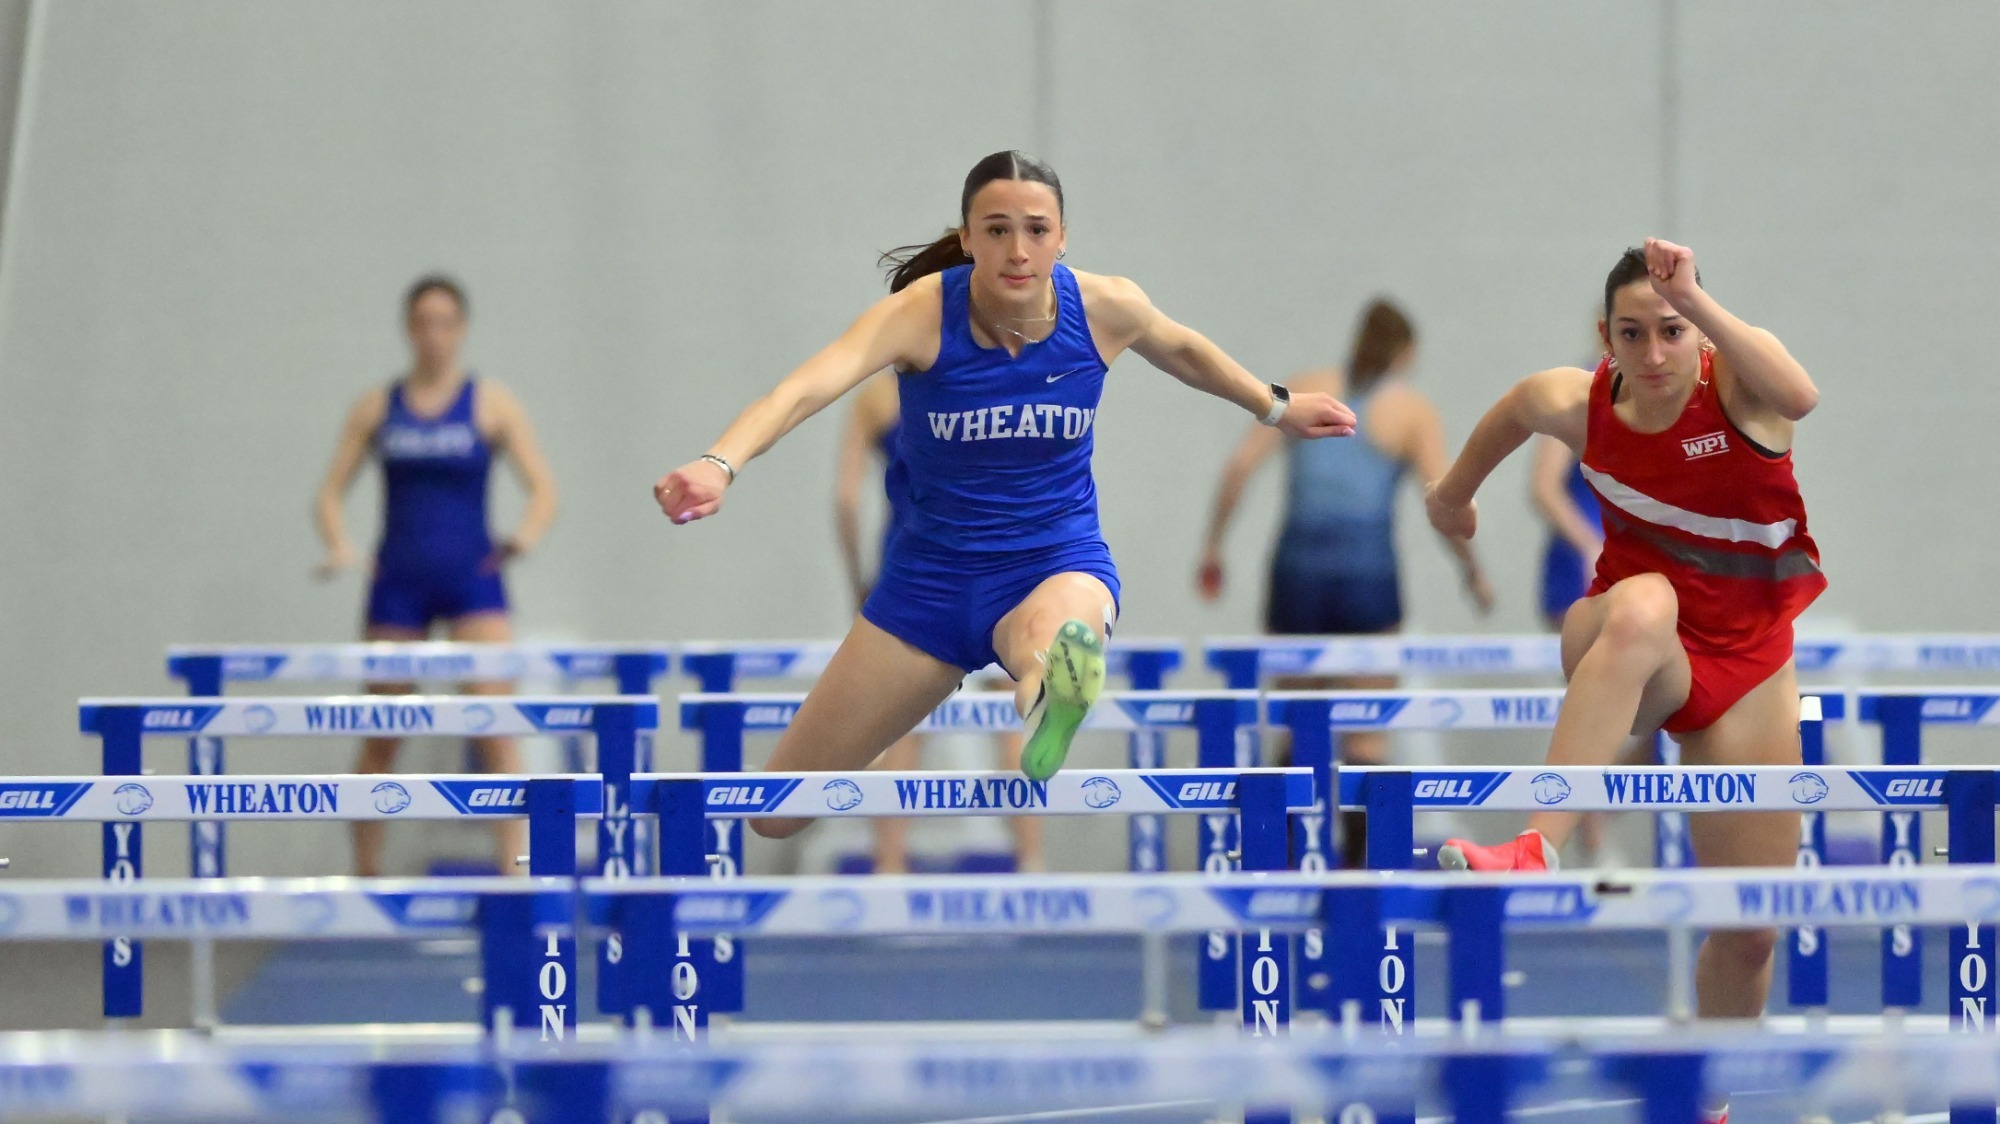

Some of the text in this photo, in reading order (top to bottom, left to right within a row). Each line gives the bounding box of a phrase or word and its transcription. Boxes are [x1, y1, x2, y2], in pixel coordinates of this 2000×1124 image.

[1681, 434, 1728, 456] WPI
[304, 705, 435, 730] WHEATON
[928, 702, 1018, 727] HEATO
[185, 784, 338, 814] WHEATON
[468, 788, 527, 806] GILL
[706, 787, 765, 805] GILL
[894, 778, 1048, 809] WHEATON
[1178, 782, 1237, 800] GILL
[1414, 780, 1473, 797] GILL
[1603, 773, 1757, 804] WHEATON
[1885, 779, 1944, 797] GILL
[0, 790, 56, 809] GILL
[1735, 882, 1921, 915] WHEATON
